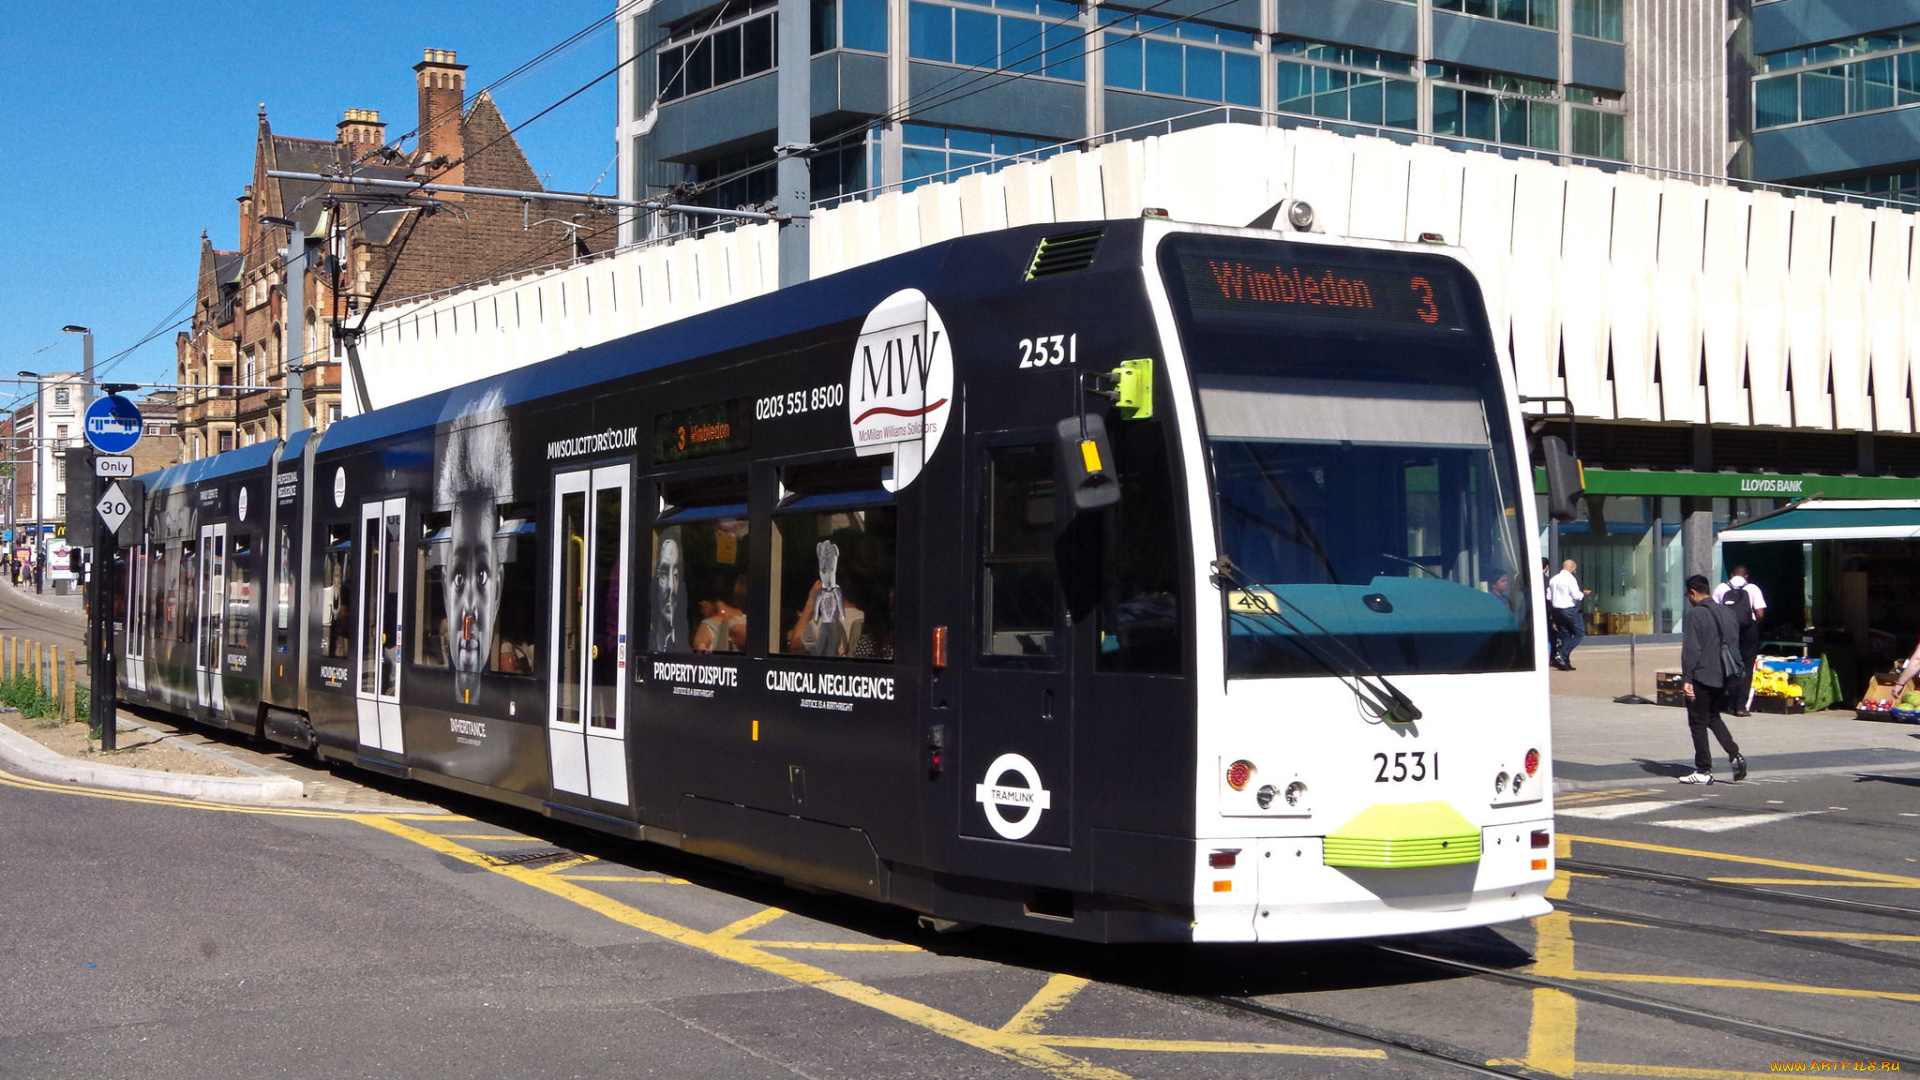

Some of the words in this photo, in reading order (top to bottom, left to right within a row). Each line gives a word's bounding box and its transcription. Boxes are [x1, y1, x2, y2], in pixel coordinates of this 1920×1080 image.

[1209, 261, 1373, 308] Wimbledon
[1410, 276, 1439, 323] 3
[1018, 332, 1077, 369] 2531
[860, 331, 940, 402] MW
[756, 394, 784, 420] 0203
[786, 390, 808, 414] 551
[811, 383, 844, 410] 8500
[677, 426, 686, 450] 3
[690, 422, 731, 443] Wimbledon
[858, 429, 883, 442] McMillan
[883, 425, 906, 438] Williams
[101, 461, 128, 473] Only
[1741, 479, 1776, 492] LLOYDS
[1777, 480, 1803, 492] BANK
[102, 501, 126, 515] 30
[653, 662, 697, 683] PROPERTY
[698, 665, 738, 687] DISPUTE
[766, 670, 816, 694] CLINICAL
[818, 674, 895, 700] NEGLIGENCE
[1373, 751, 1439, 783] 2531
[991, 789, 1034, 803] TRAMLINK
